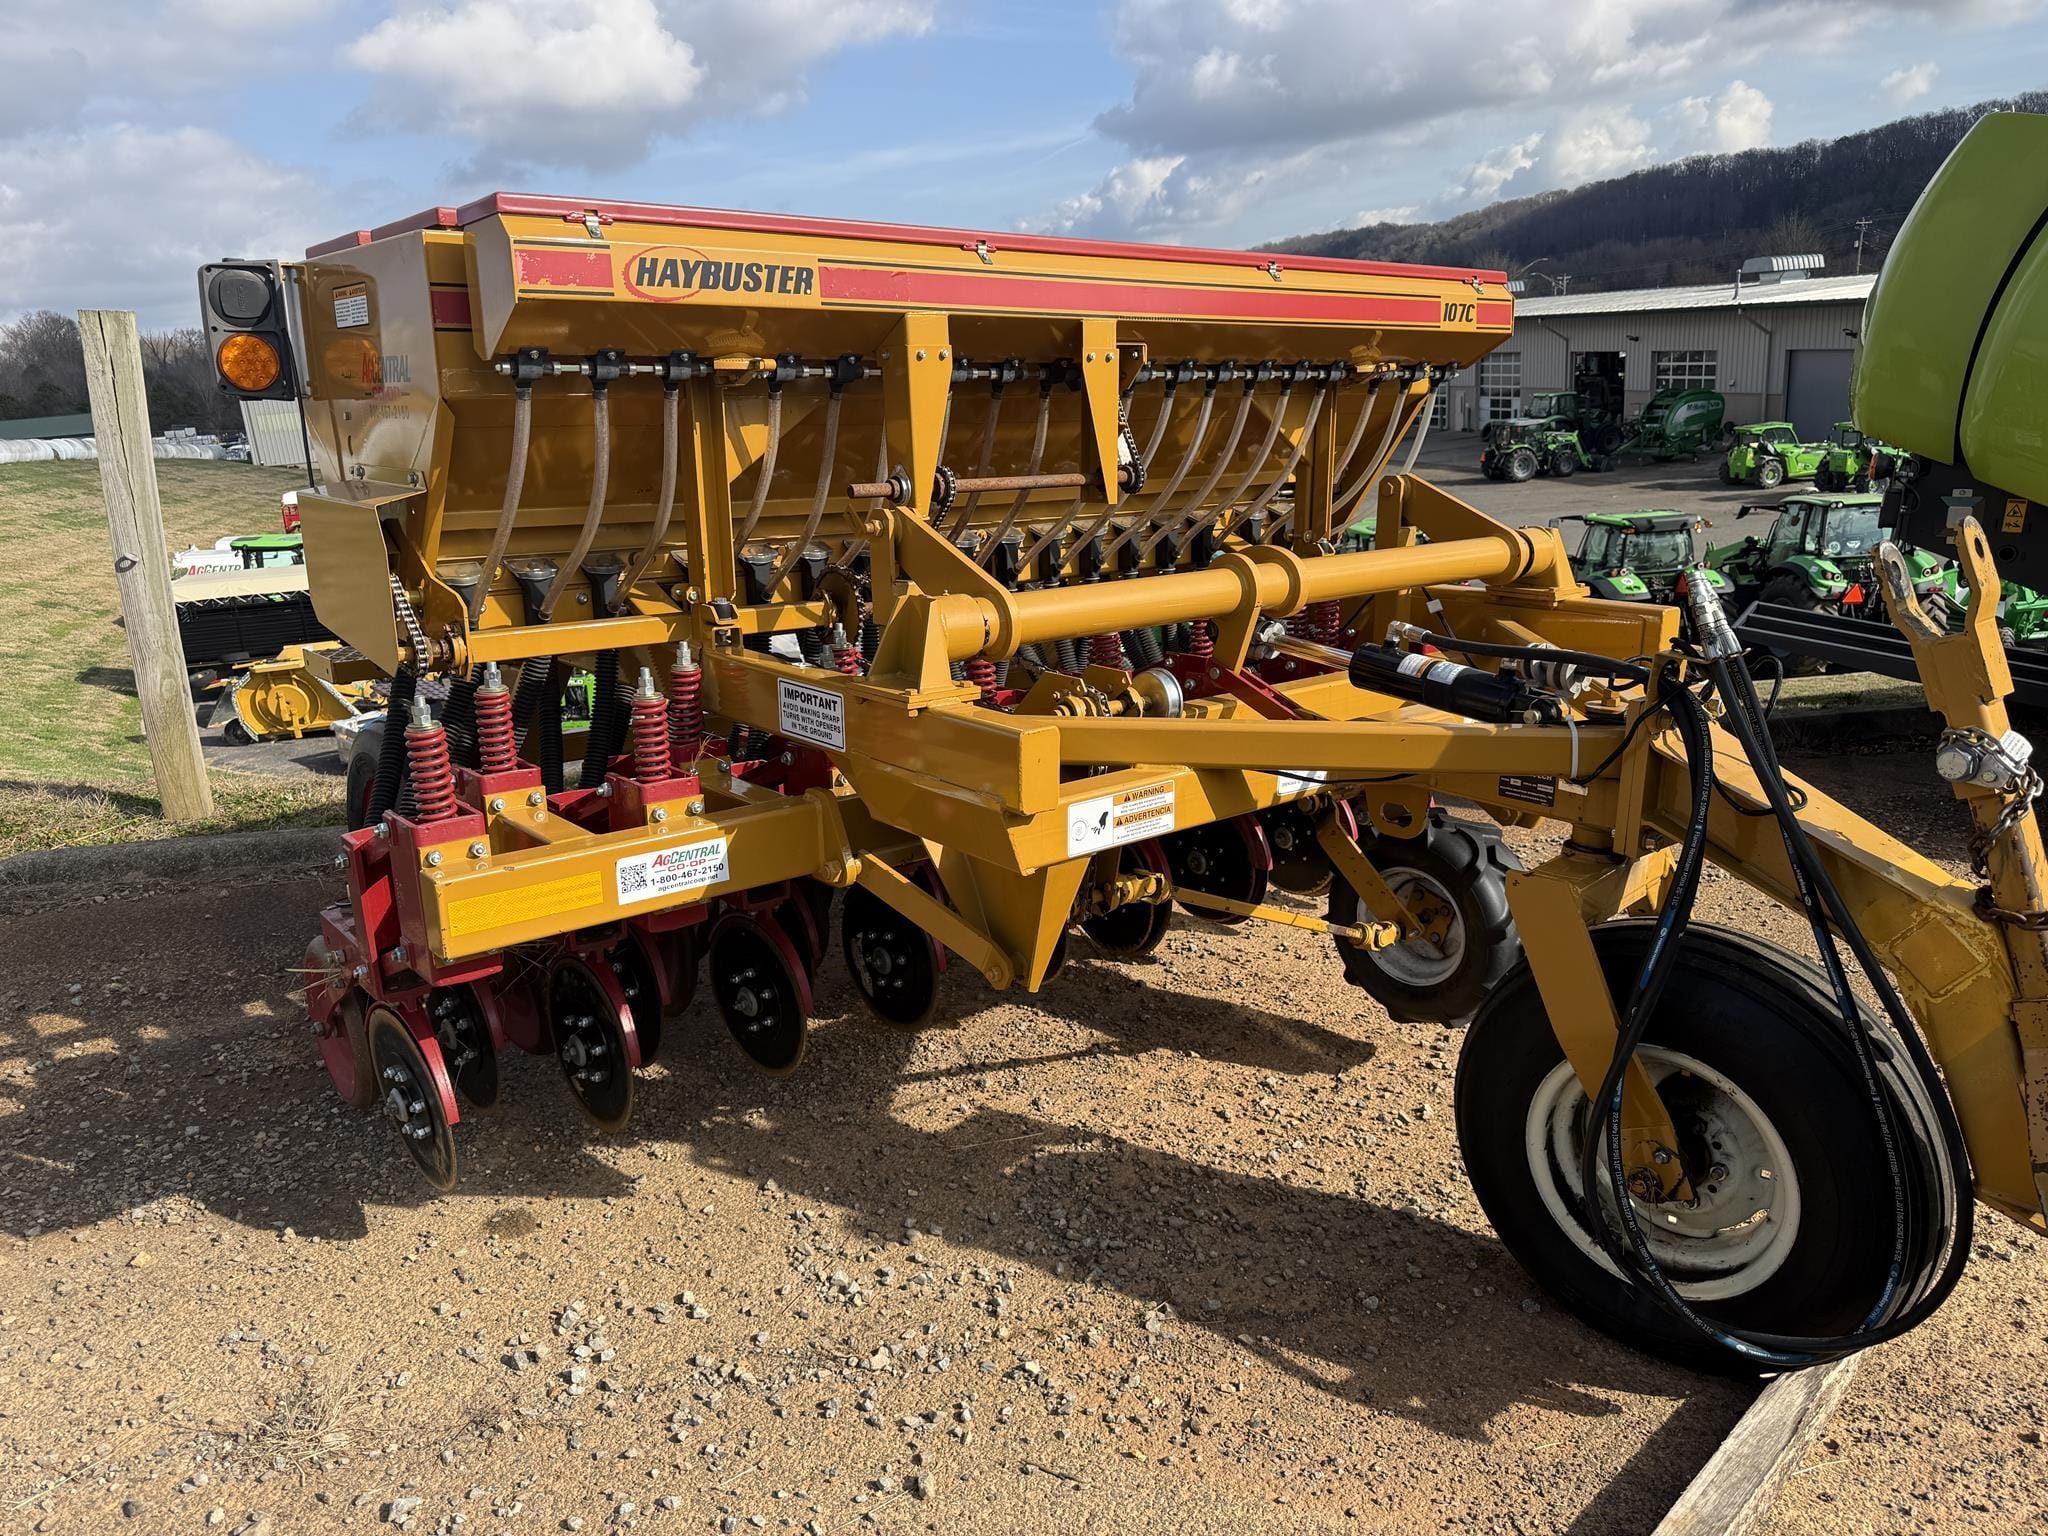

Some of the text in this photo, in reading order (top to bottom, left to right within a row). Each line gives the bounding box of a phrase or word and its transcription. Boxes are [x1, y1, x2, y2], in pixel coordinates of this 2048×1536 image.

[635, 257, 814, 296] HAYBUSTER
[1443, 302, 1475, 322] 107C
[784, 687, 838, 712] IMPORTANT
[783, 702, 840, 723] AVOID MAKING SHARP
[783, 710, 841, 734] TURNS WITH OPENERS
[792, 721, 832, 740] IN THE GROUND
[1131, 785, 1165, 800] WARNING
[1124, 806, 1171, 824] ADVERTENCIA
[651, 863, 724, 886] 1-800-467-2150
[668, 858, 706, 872] CO-OP
